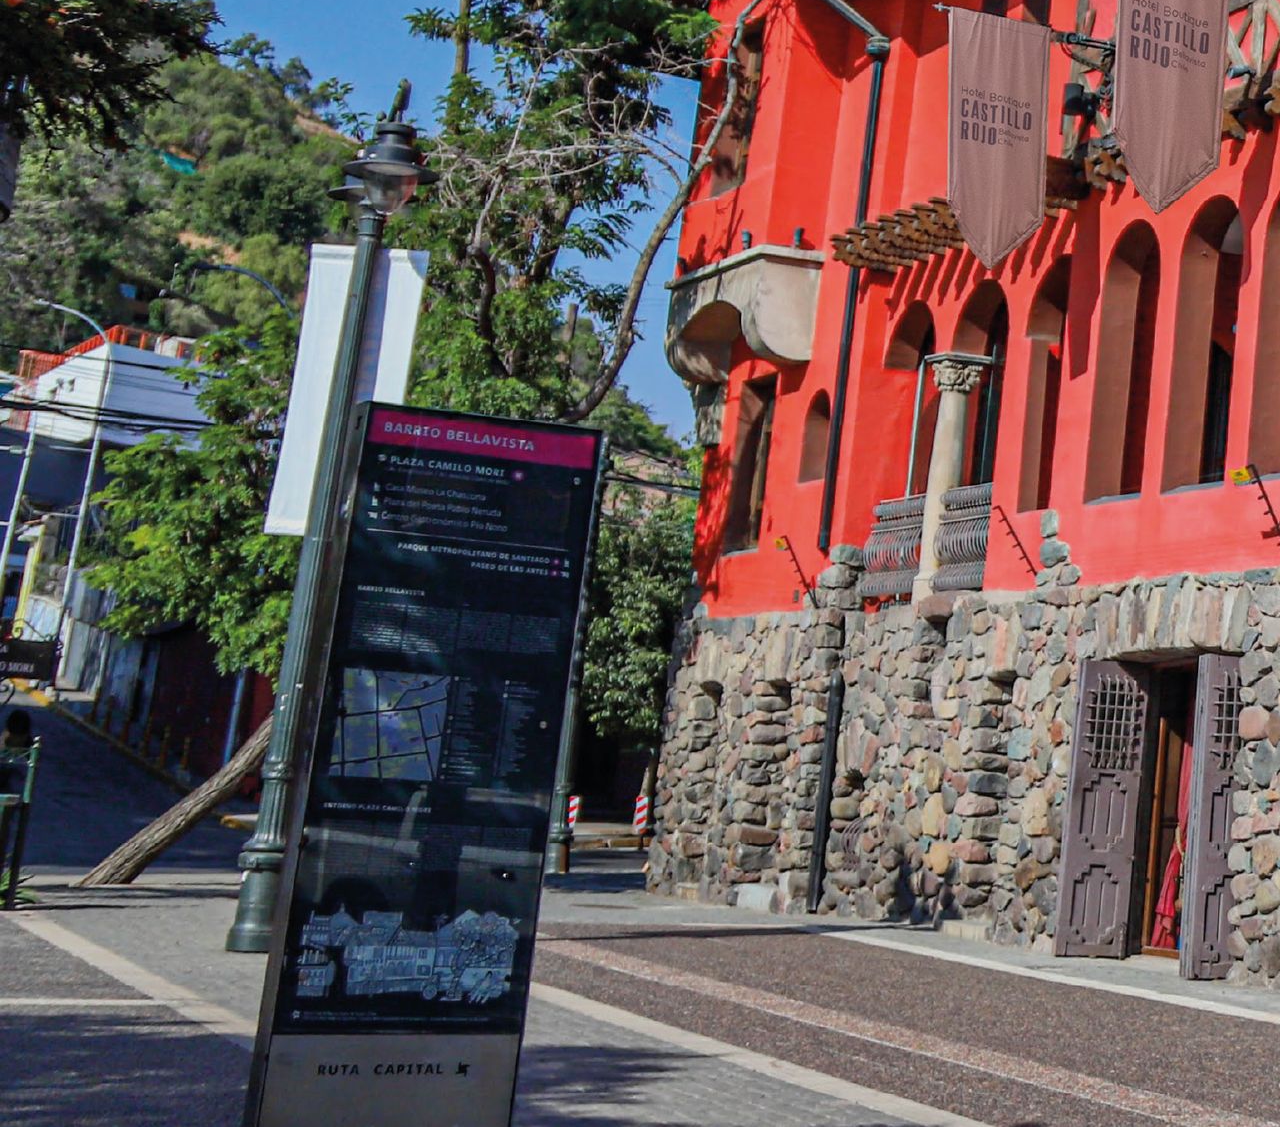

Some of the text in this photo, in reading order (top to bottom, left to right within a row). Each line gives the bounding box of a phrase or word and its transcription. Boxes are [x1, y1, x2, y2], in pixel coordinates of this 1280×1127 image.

[1163, 5, 1209, 29] Boutique
[1130, 8, 1210, 55] CASTILLO
[1129, 34, 1171, 69] ROJO
[961, 84, 1031, 109] Hotel Boutique
[960, 97, 1032, 131] CASTILLO
[960, 120, 997, 146] ROJO
[384, 421, 535, 452] BARRIO BELLAVISTA
[390, 455, 425, 467] PLAZA
[428, 459, 472, 473] CAMILO
[475, 465, 505, 478] MORI
[397, 542, 429, 552] PARQUE
[317, 1063, 444, 1076] RUTA CAPITAL
